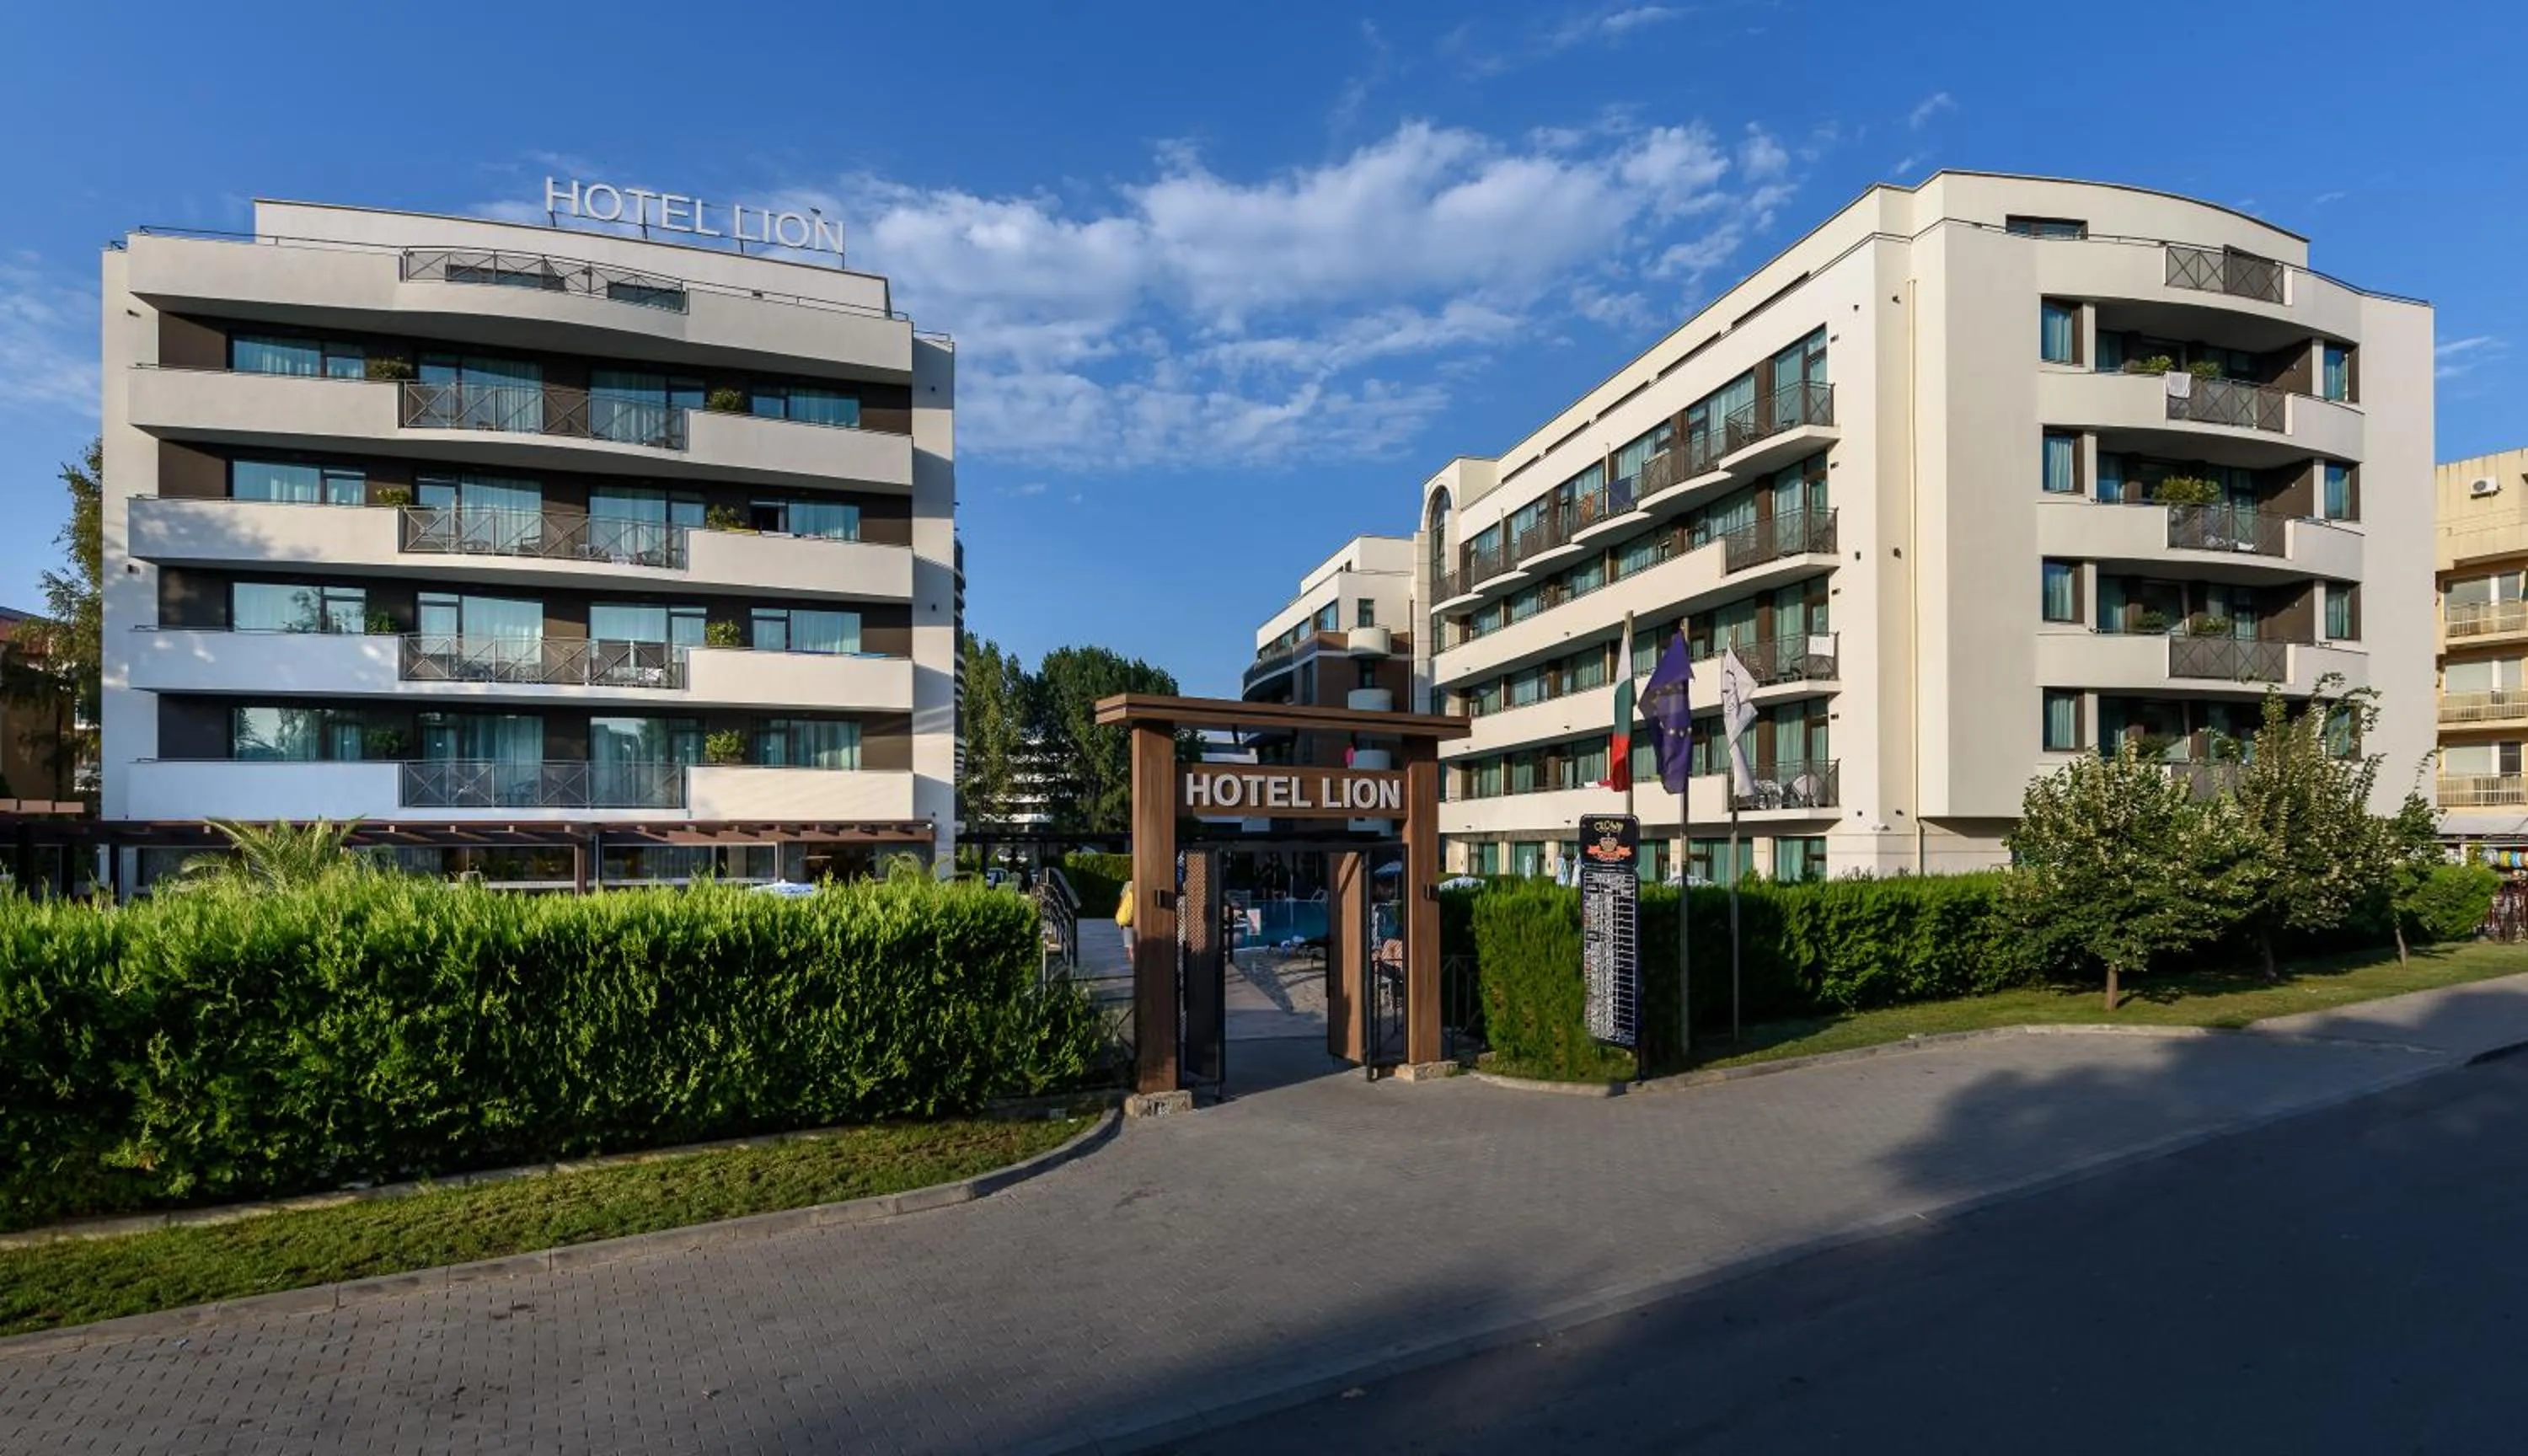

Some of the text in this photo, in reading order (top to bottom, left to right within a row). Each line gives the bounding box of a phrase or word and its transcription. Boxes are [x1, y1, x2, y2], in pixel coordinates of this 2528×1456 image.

[546, 176, 844, 254] HOTEL LION
[1186, 773, 1401, 810] HOTEL LION
